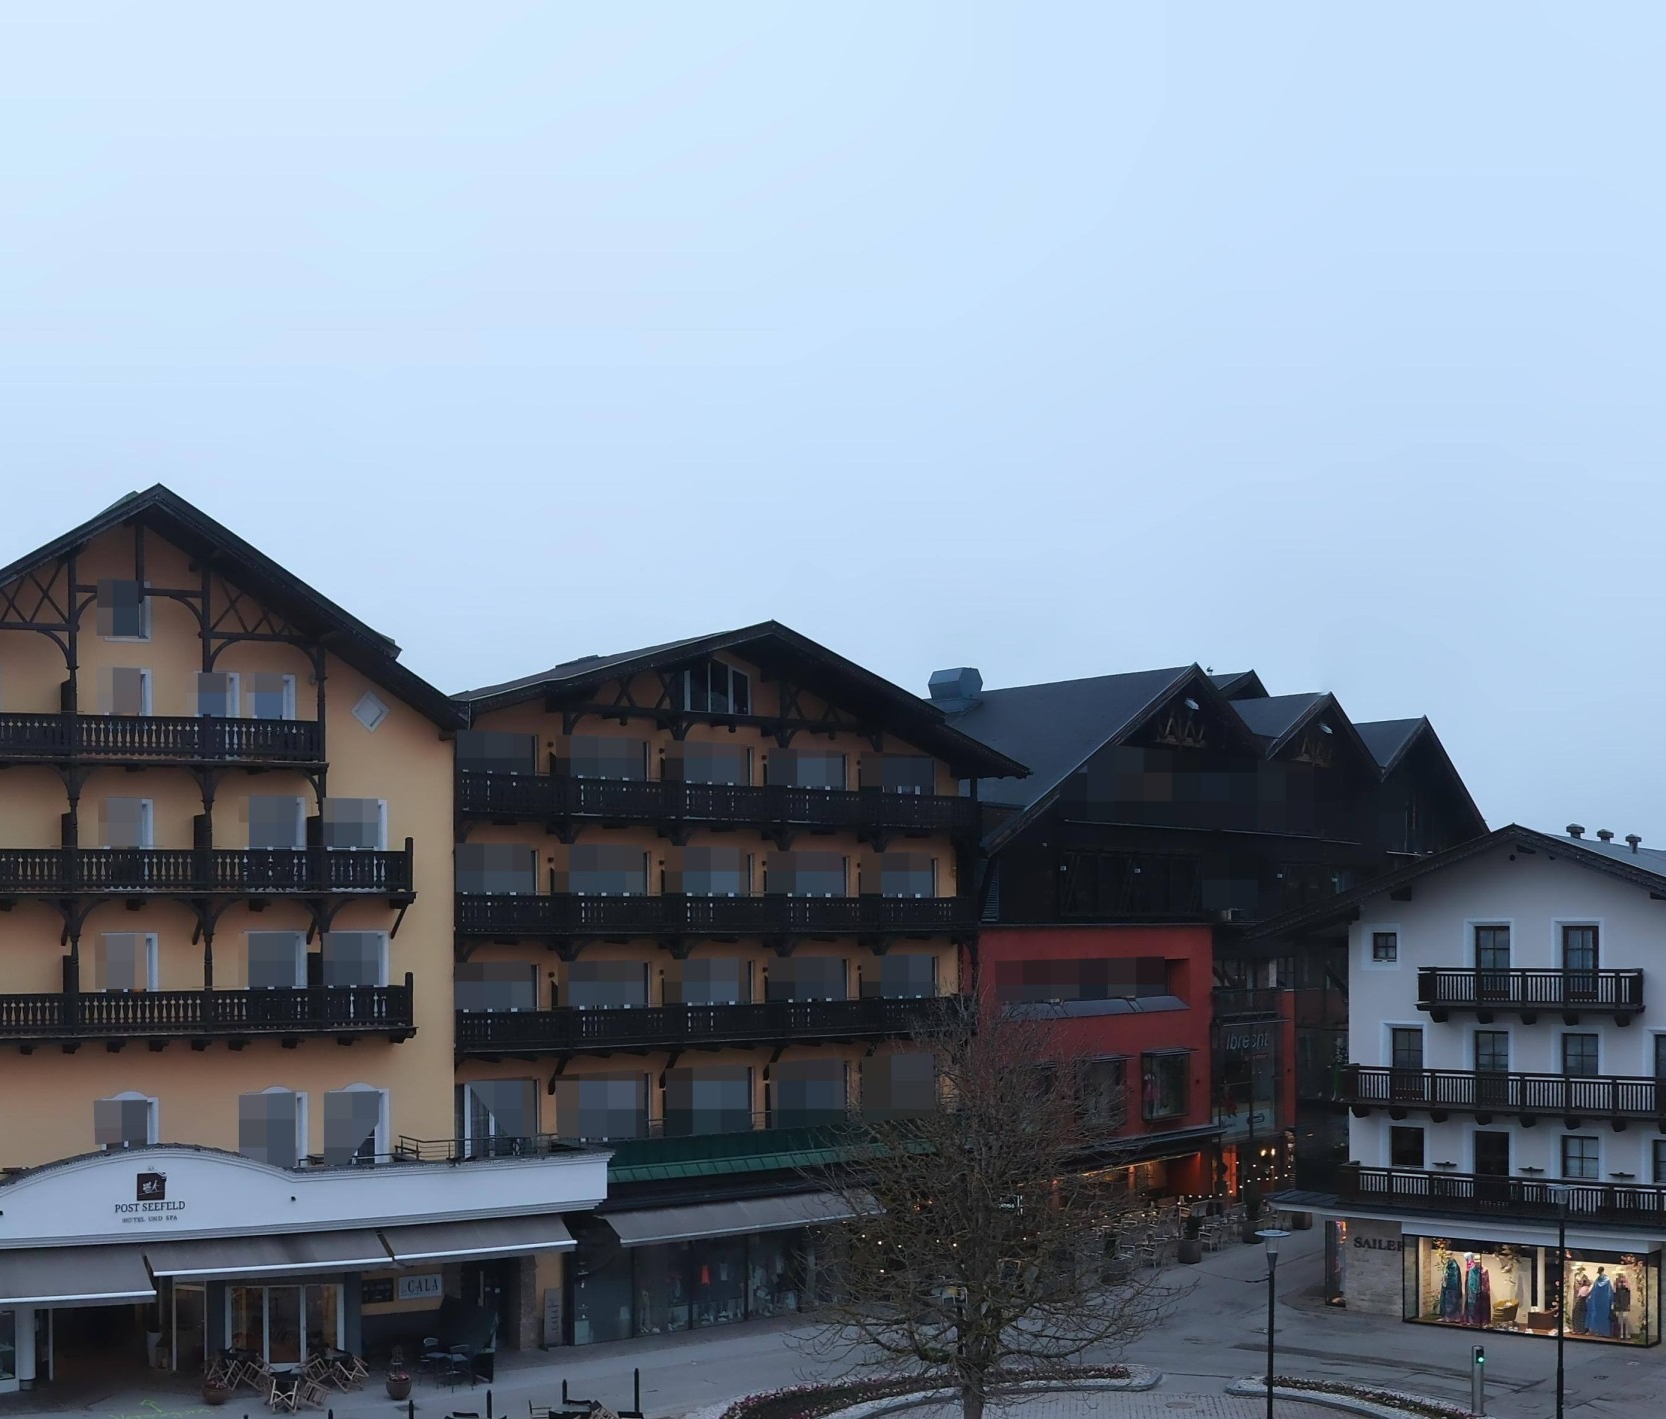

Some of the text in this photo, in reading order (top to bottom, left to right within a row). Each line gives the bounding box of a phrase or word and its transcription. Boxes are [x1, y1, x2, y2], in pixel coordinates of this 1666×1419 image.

[115, 1201, 186, 1213] POST SEEFELD
[407, 1278, 439, 1293] CALA
